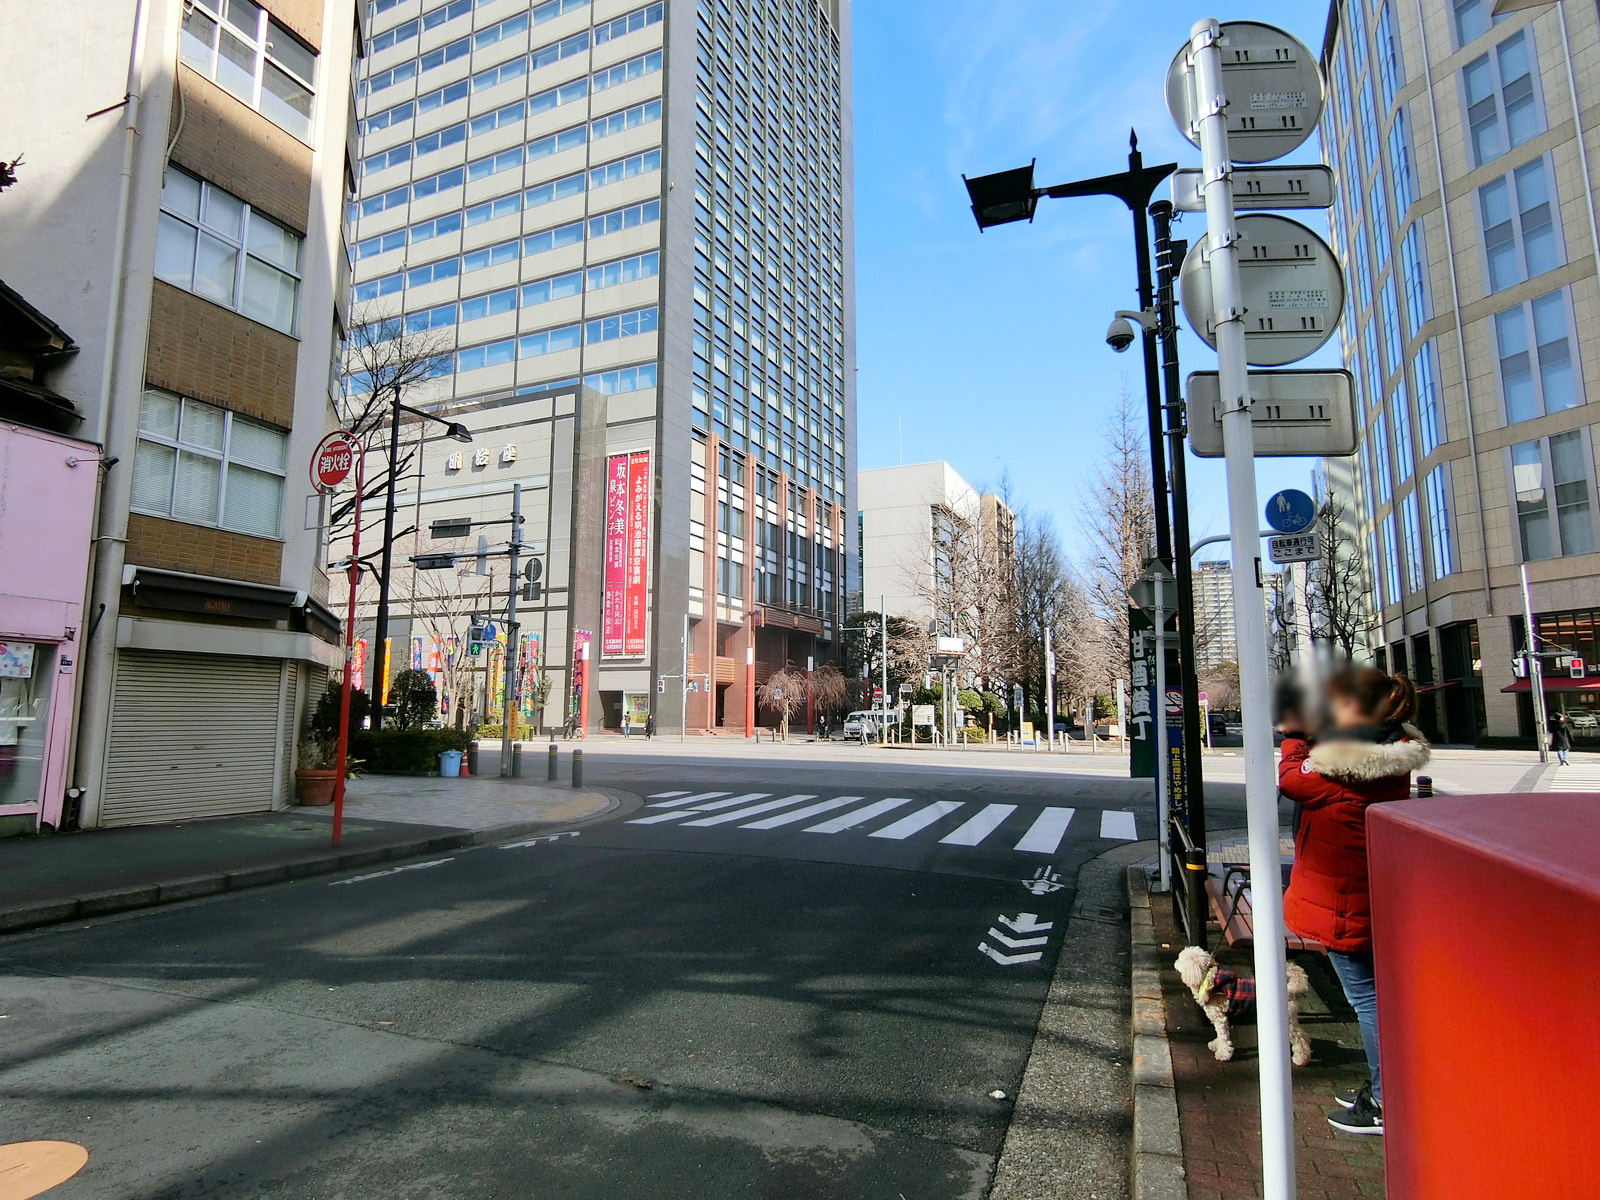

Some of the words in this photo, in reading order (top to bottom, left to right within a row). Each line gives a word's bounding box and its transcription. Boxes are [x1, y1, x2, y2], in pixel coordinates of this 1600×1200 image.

[320, 452, 350, 474] 消火栓
[448, 443, 517, 470] 明治座
[608, 479, 616, 536] 泉ピン子
[614, 462, 626, 535] 坂本冬美
[632, 476, 642, 584] よみがえる明治座東京喜劇
[1273, 546, 1314, 558] ここまで
[1131, 630, 1152, 740] 甘酒横丁
